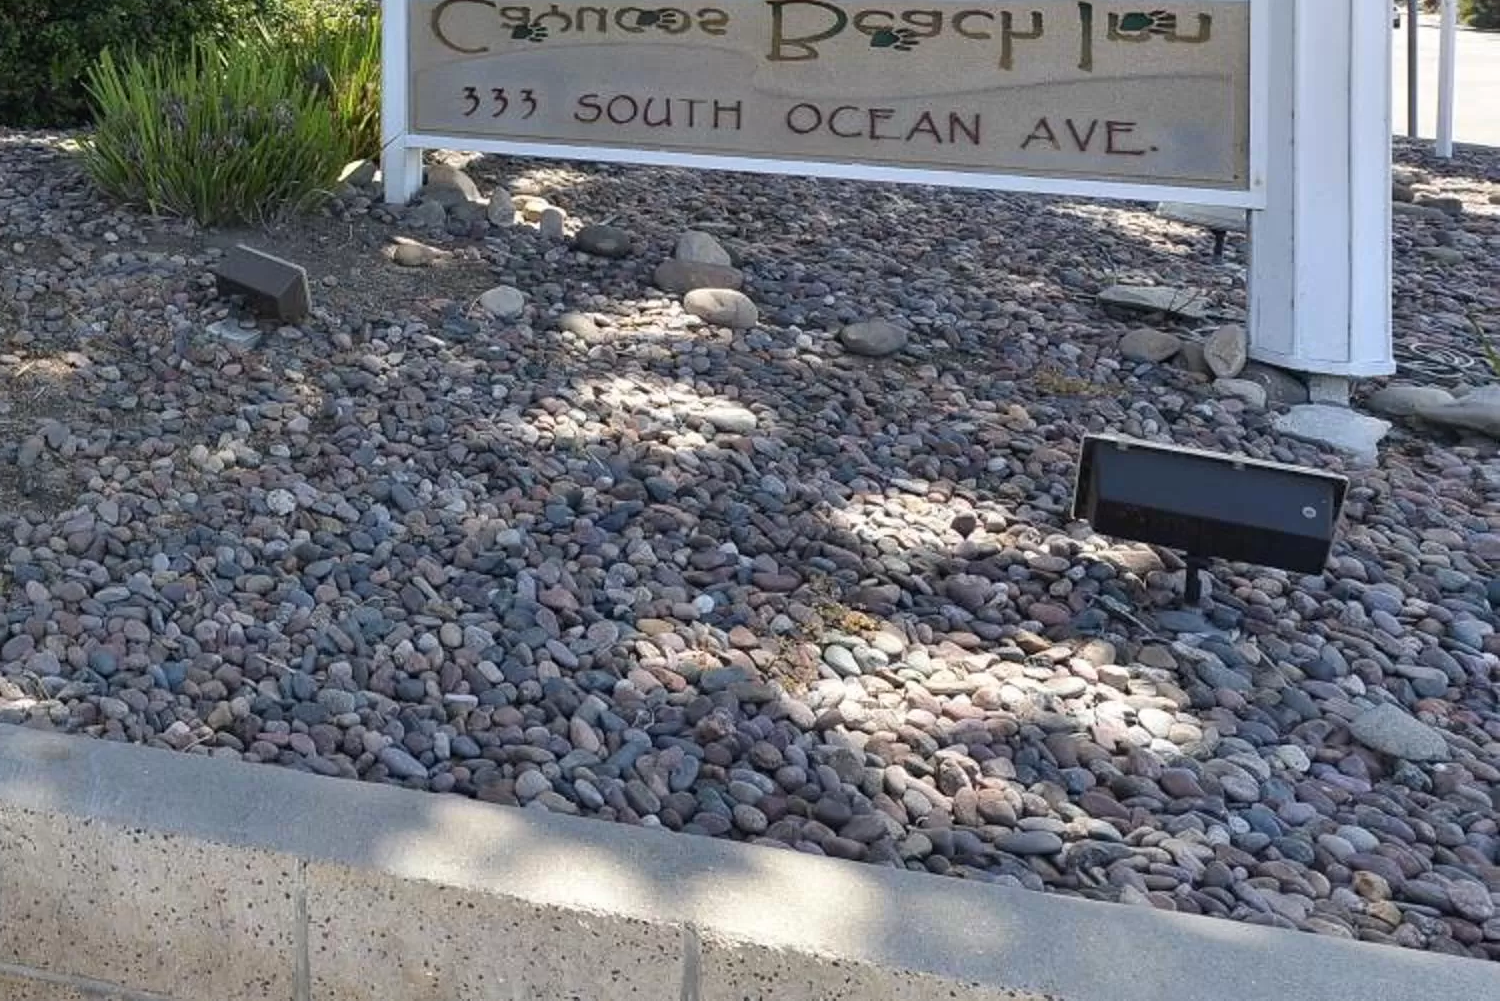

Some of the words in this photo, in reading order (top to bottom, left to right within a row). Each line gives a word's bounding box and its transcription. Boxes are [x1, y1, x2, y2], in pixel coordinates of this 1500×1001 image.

[462, 85, 538, 120] 333
[572, 93, 743, 131] SOUTH
[785, 102, 981, 146] OCEAN
[1019, 116, 1160, 156] AVE.
